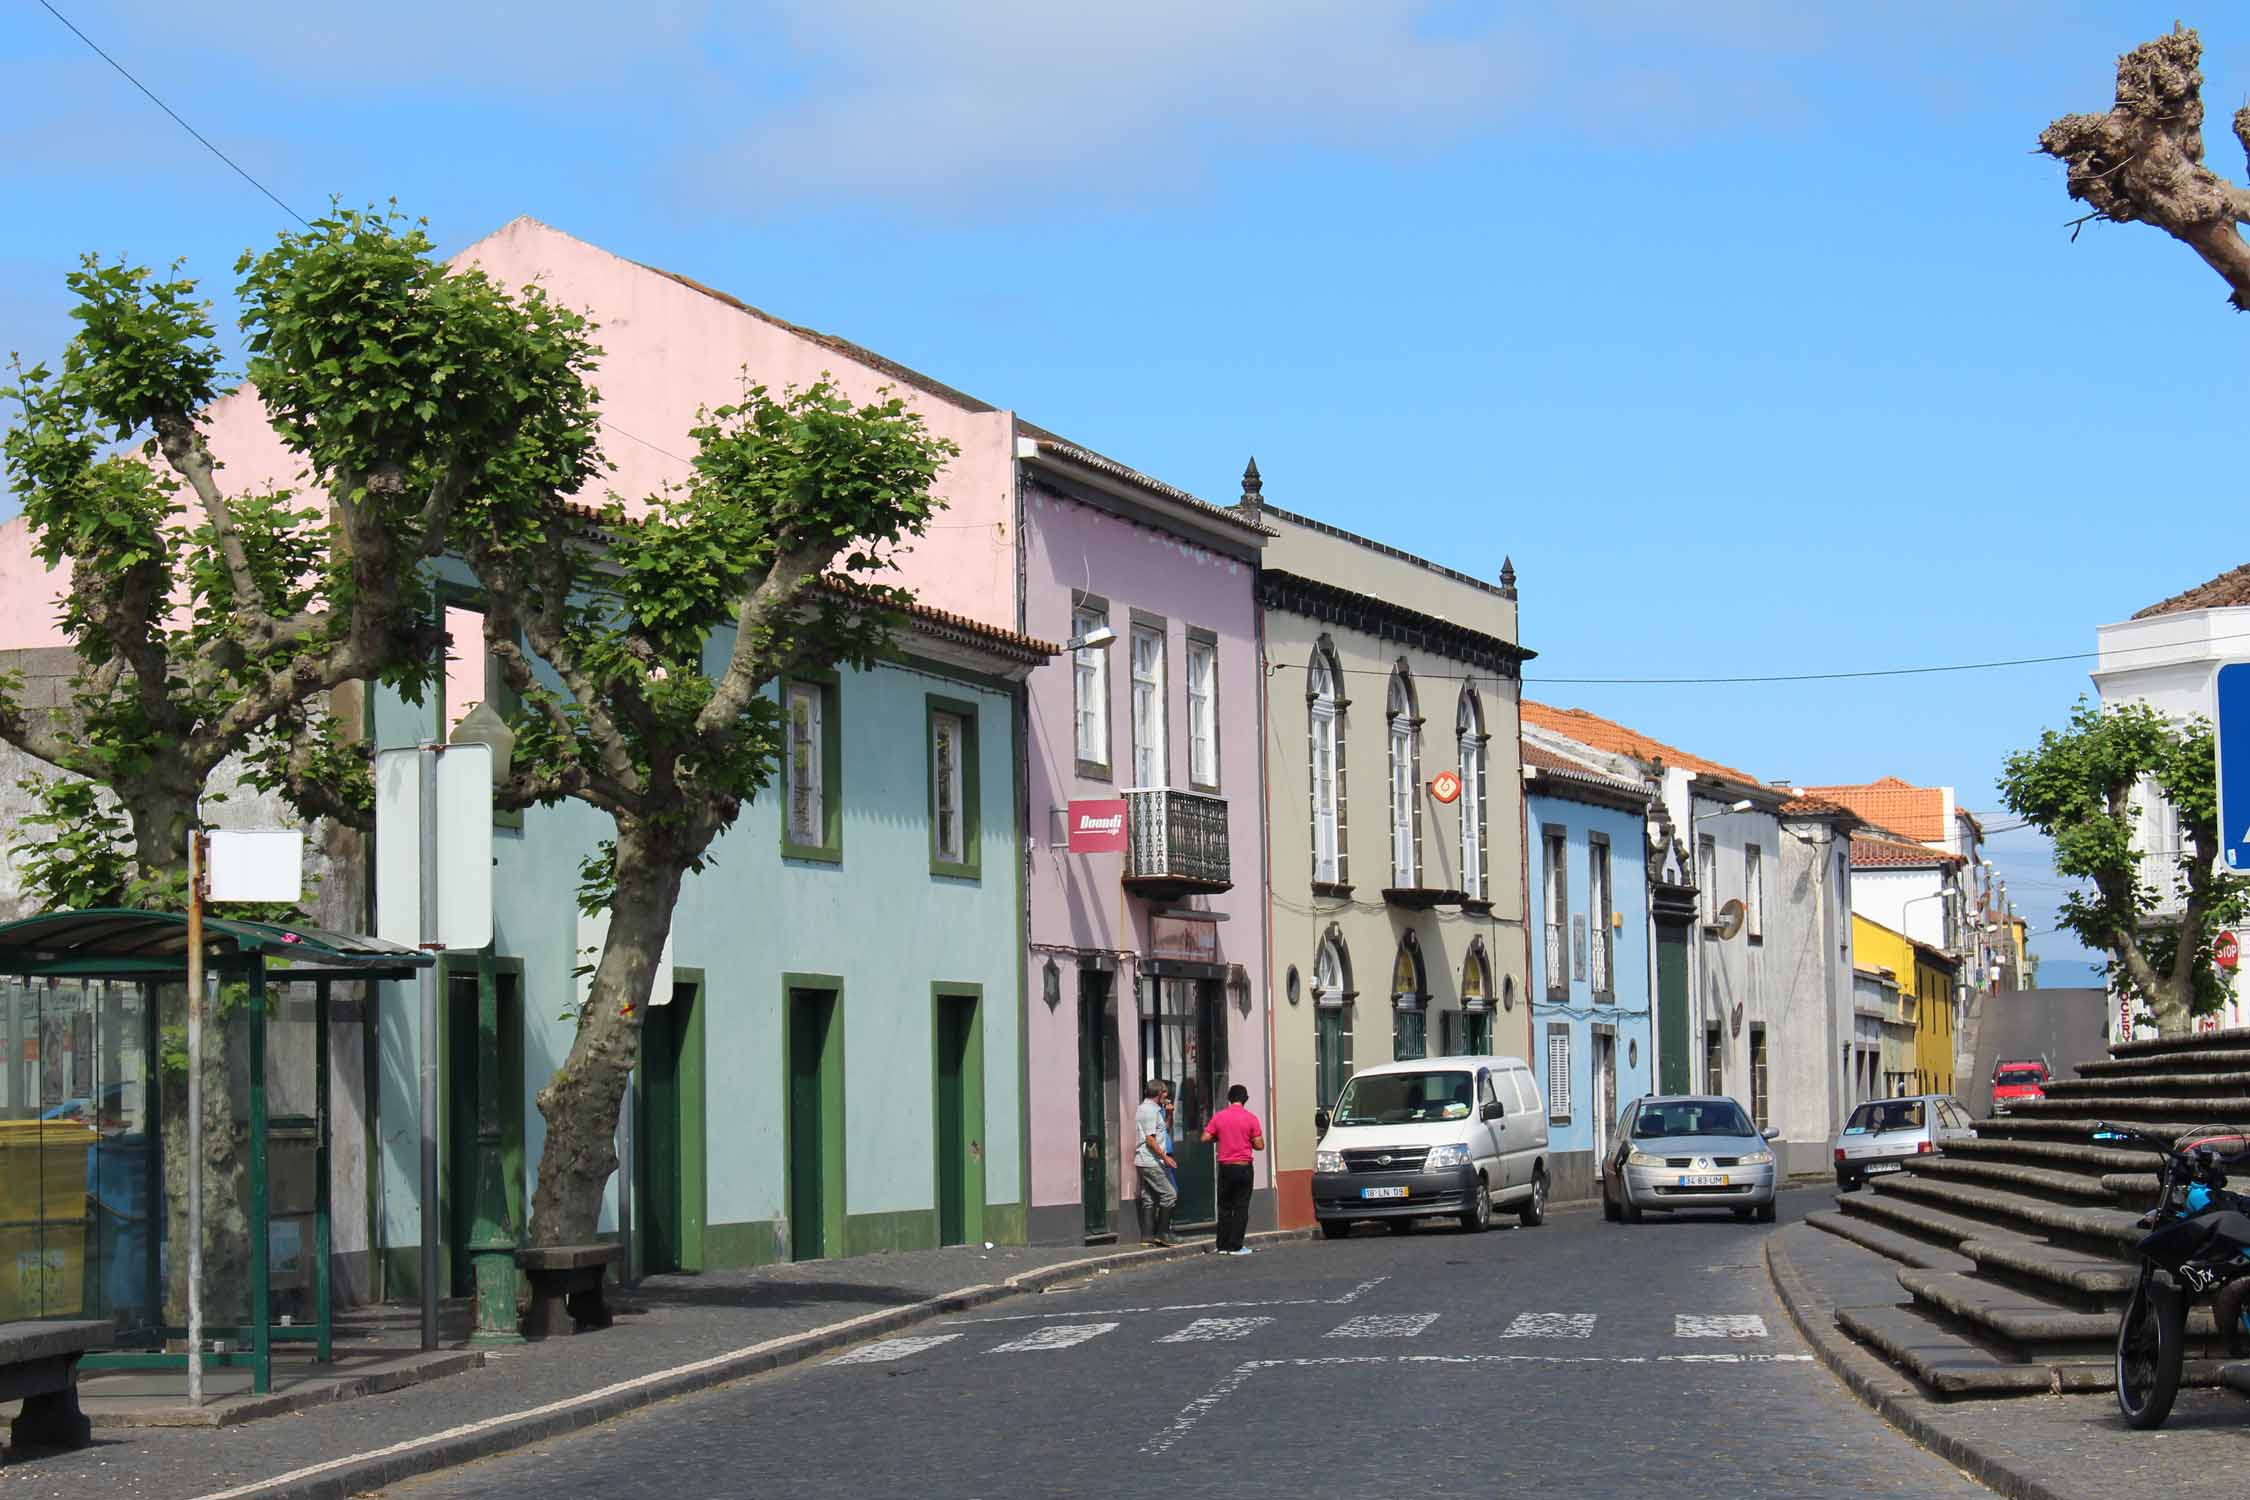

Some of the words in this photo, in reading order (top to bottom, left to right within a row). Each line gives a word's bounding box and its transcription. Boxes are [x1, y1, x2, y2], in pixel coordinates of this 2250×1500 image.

[2216, 945, 2237, 959] STOP
[2120, 992, 2131, 1041] OCERY
[1709, 1176, 1722, 1184] UM
